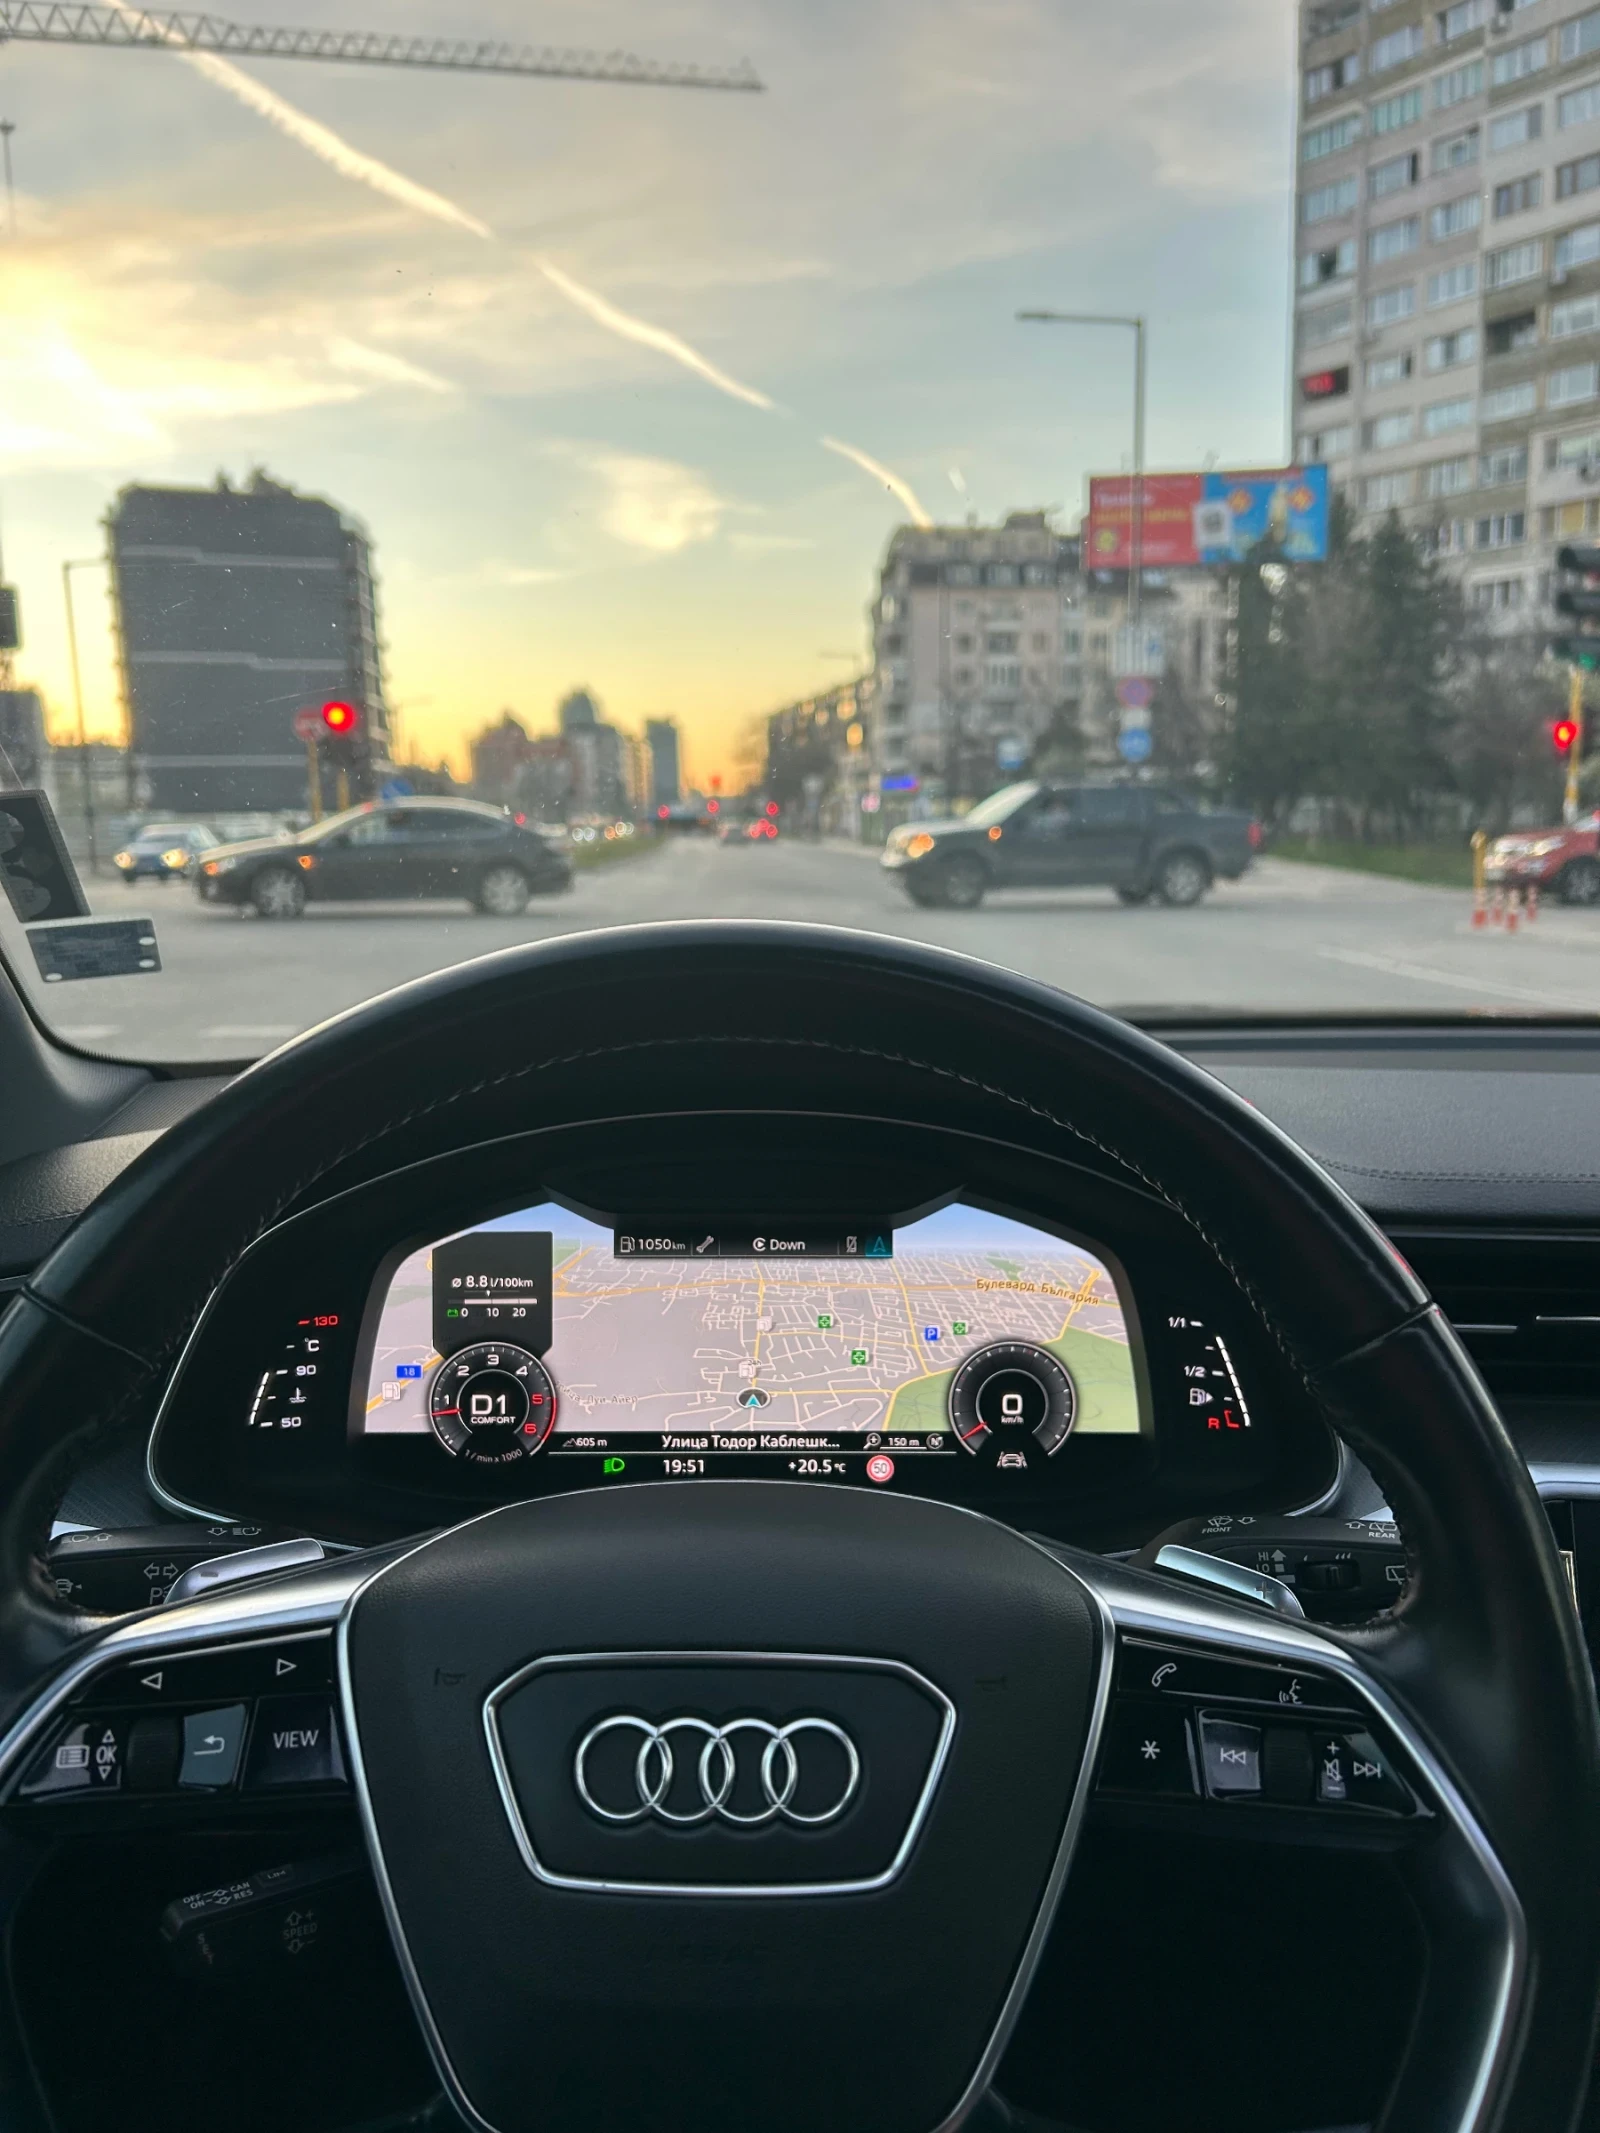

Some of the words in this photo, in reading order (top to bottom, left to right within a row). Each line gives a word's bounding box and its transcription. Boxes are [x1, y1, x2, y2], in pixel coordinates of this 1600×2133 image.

[769, 1239, 806, 1251] Down
[466, 1275, 488, 1288] 8.8
[976, 1279, 1035, 1292] Булевард
[1040, 1282, 1099, 1305] България
[461, 1307, 469, 1317] 0
[486, 1307, 500, 1317] 10
[512, 1307, 527, 1317] 20
[313, 1315, 338, 1326] 130
[1168, 1316, 1186, 1328] 1/1
[487, 1354, 500, 1365] 3
[296, 1364, 317, 1376] 90
[403, 1366, 416, 1377] 18
[457, 1365, 470, 1376] 2
[515, 1365, 529, 1376] 4
[1184, 1365, 1206, 1378] 1/2
[443, 1394, 450, 1405] 1
[471, 1394, 506, 1415] D1
[532, 1394, 543, 1405] 5
[1002, 1394, 1023, 1415] 0
[281, 1416, 301, 1428] 50
[471, 1416, 516, 1424] COMFORT
[1208, 1417, 1220, 1429] R
[524, 1423, 537, 1434] 6
[576, 1437, 595, 1447] 605
[597, 1438, 608, 1447] m
[661, 1435, 708, 1450] Улица
[712, 1435, 757, 1450] Тодор
[761, 1435, 840, 1448] Каблешк...
[888, 1437, 907, 1446] 150
[662, 1459, 705, 1473] 19:51
[873, 1463, 888, 1474] 50
[1201, 1526, 1232, 1534] FRONT
[1368, 1531, 1396, 1539] REAR
[1258, 1551, 1270, 1561] HI
[273, 1729, 319, 1749] VIEW
[96, 1745, 118, 1765] OK
[183, 1892, 203, 1904] OFF
[229, 1881, 250, 1893] CAN
[190, 1899, 205, 1910] ON
[233, 1888, 254, 1901] RES
[282, 1922, 318, 1941] SPEED
